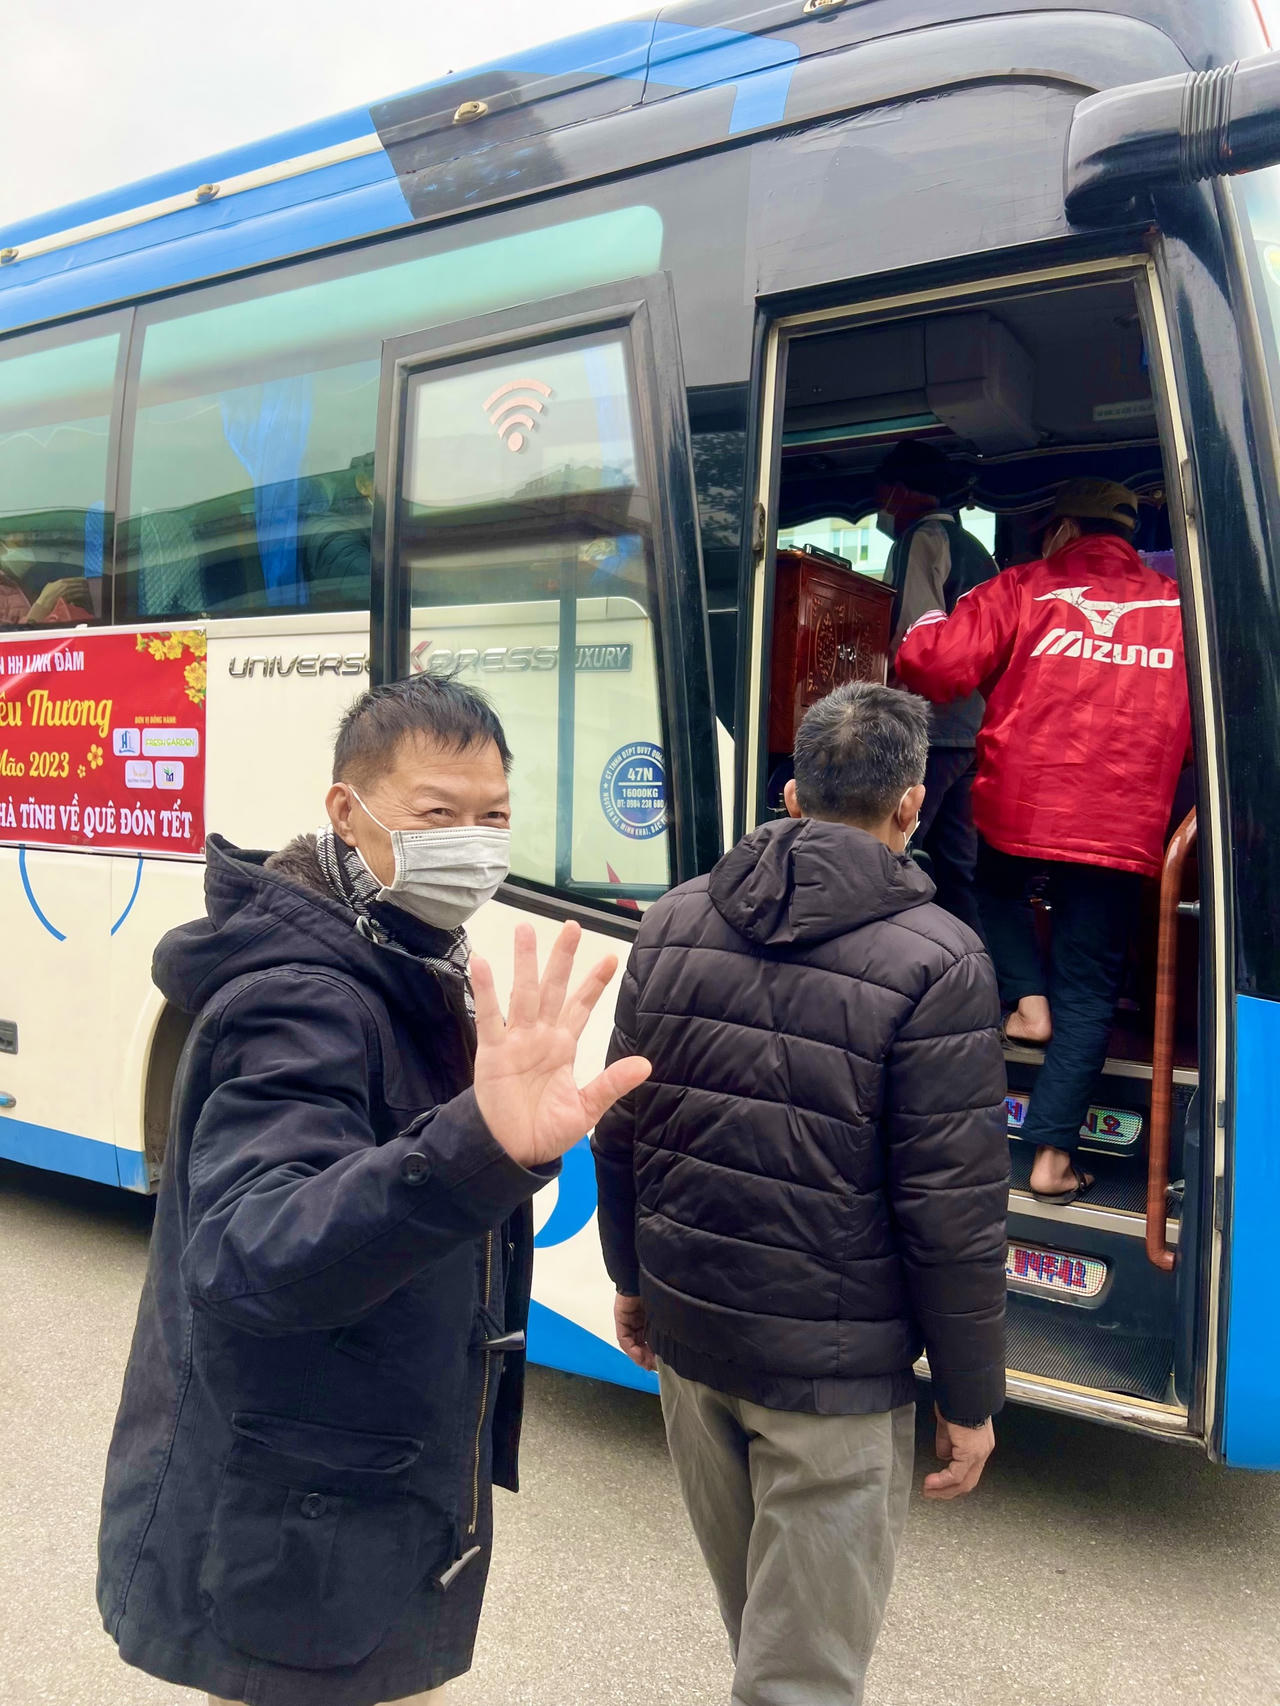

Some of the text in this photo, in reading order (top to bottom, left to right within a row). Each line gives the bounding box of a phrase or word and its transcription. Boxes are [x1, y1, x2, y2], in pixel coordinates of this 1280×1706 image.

[54, 647, 85, 672] ĐÀM
[1030, 628, 1174, 669] MIZUNO
[228, 653, 370, 678] UNIVERS
[26, 689, 113, 738] Thương
[166, 736, 195, 747] GARDEN
[29, 751, 70, 779] 2023
[627, 767, 653, 781] 47N
[621, 788, 659, 798] 16000KG
[20, 796, 56, 831] TĨNH
[59, 792, 81, 832] VỀ
[83, 800, 116, 839] QUÊ
[120, 801, 156, 836] ĐÓN
[160, 798, 193, 839] TẾT
